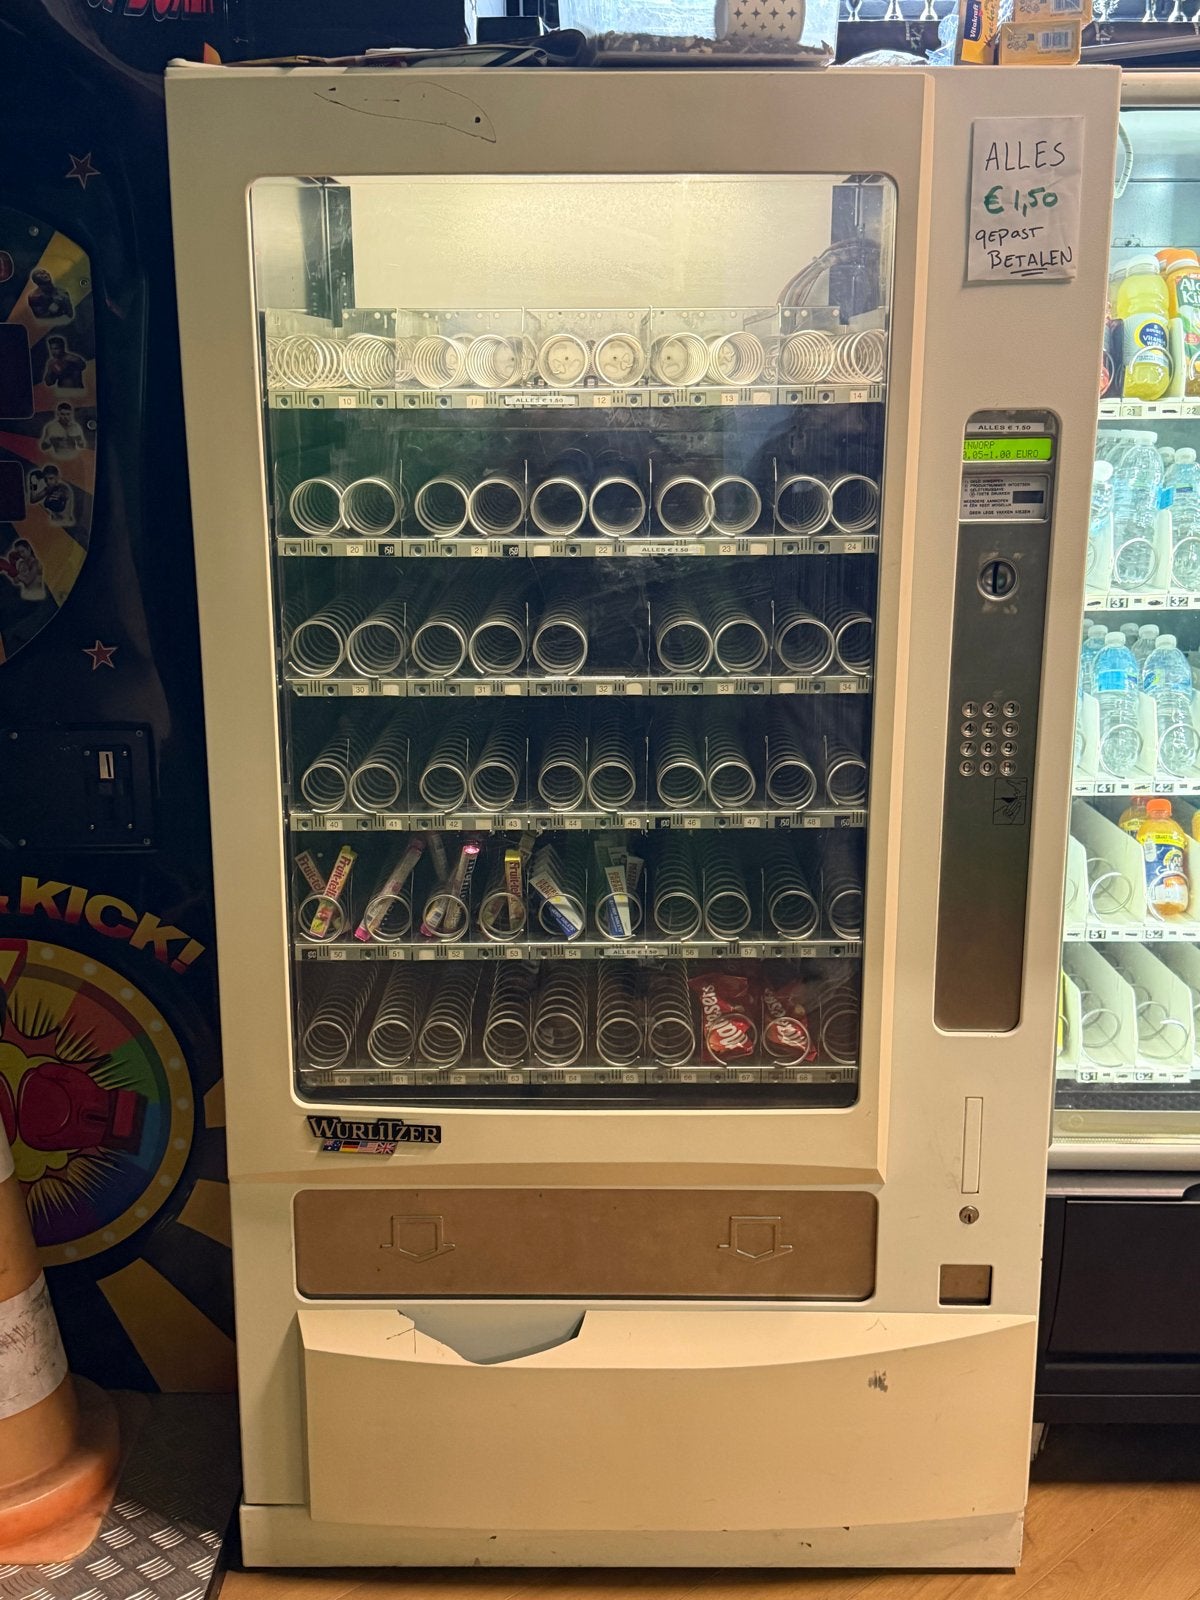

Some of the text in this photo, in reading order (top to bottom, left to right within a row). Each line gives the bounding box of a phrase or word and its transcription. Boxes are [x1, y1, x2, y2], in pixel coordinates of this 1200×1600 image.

[969, 3, 980, 39] Vitakraft
[985, 140, 1066, 171] ALLES
[983, 185, 1058, 217] € 1,50
[987, 246, 1073, 269] BETALEN
[964, 441, 995, 449] INWORP
[1016, 450, 1039, 458] EURO
[986, 703, 994, 714] 2
[1008, 703, 1015, 714] 3
[964, 722, 1013, 733] 4 5 6
[985, 742, 992, 753] 8
[1004, 742, 1012, 753] 9
[983, 762, 991, 773] 0
[299, 855, 326, 892] Fruit-tel
[325, 855, 351, 900] Fruit-tell
[19, 876, 206, 975] KICK!
